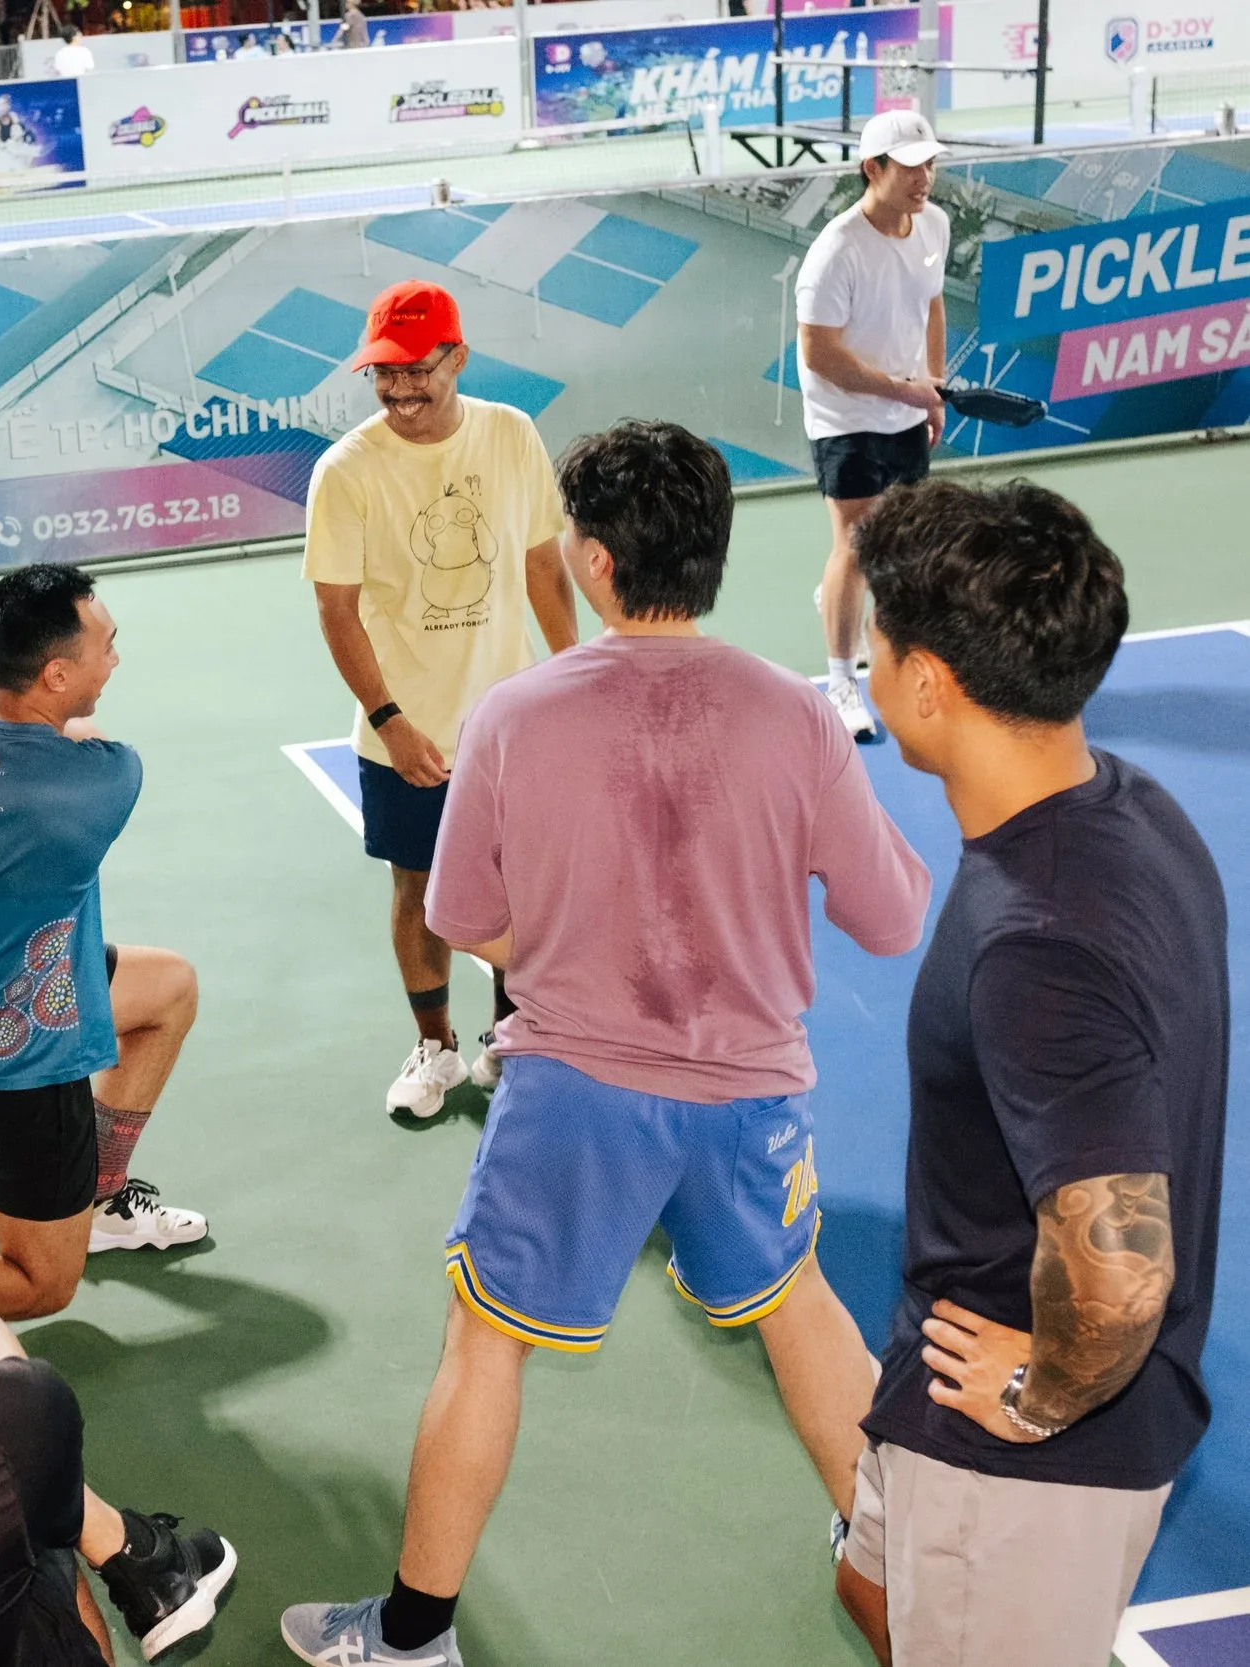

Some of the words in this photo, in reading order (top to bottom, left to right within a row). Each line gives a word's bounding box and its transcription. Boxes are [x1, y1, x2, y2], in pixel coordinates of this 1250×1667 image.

[1146, 17, 1214, 39] D-JOY
[628, 48, 759, 106] KHÁM
[787, 77, 843, 103] D-JO
[1082, 323, 1192, 387] NAM
[32, 492, 241, 542] 0932.76.32.18
[424, 622, 459, 632] ALREADY
